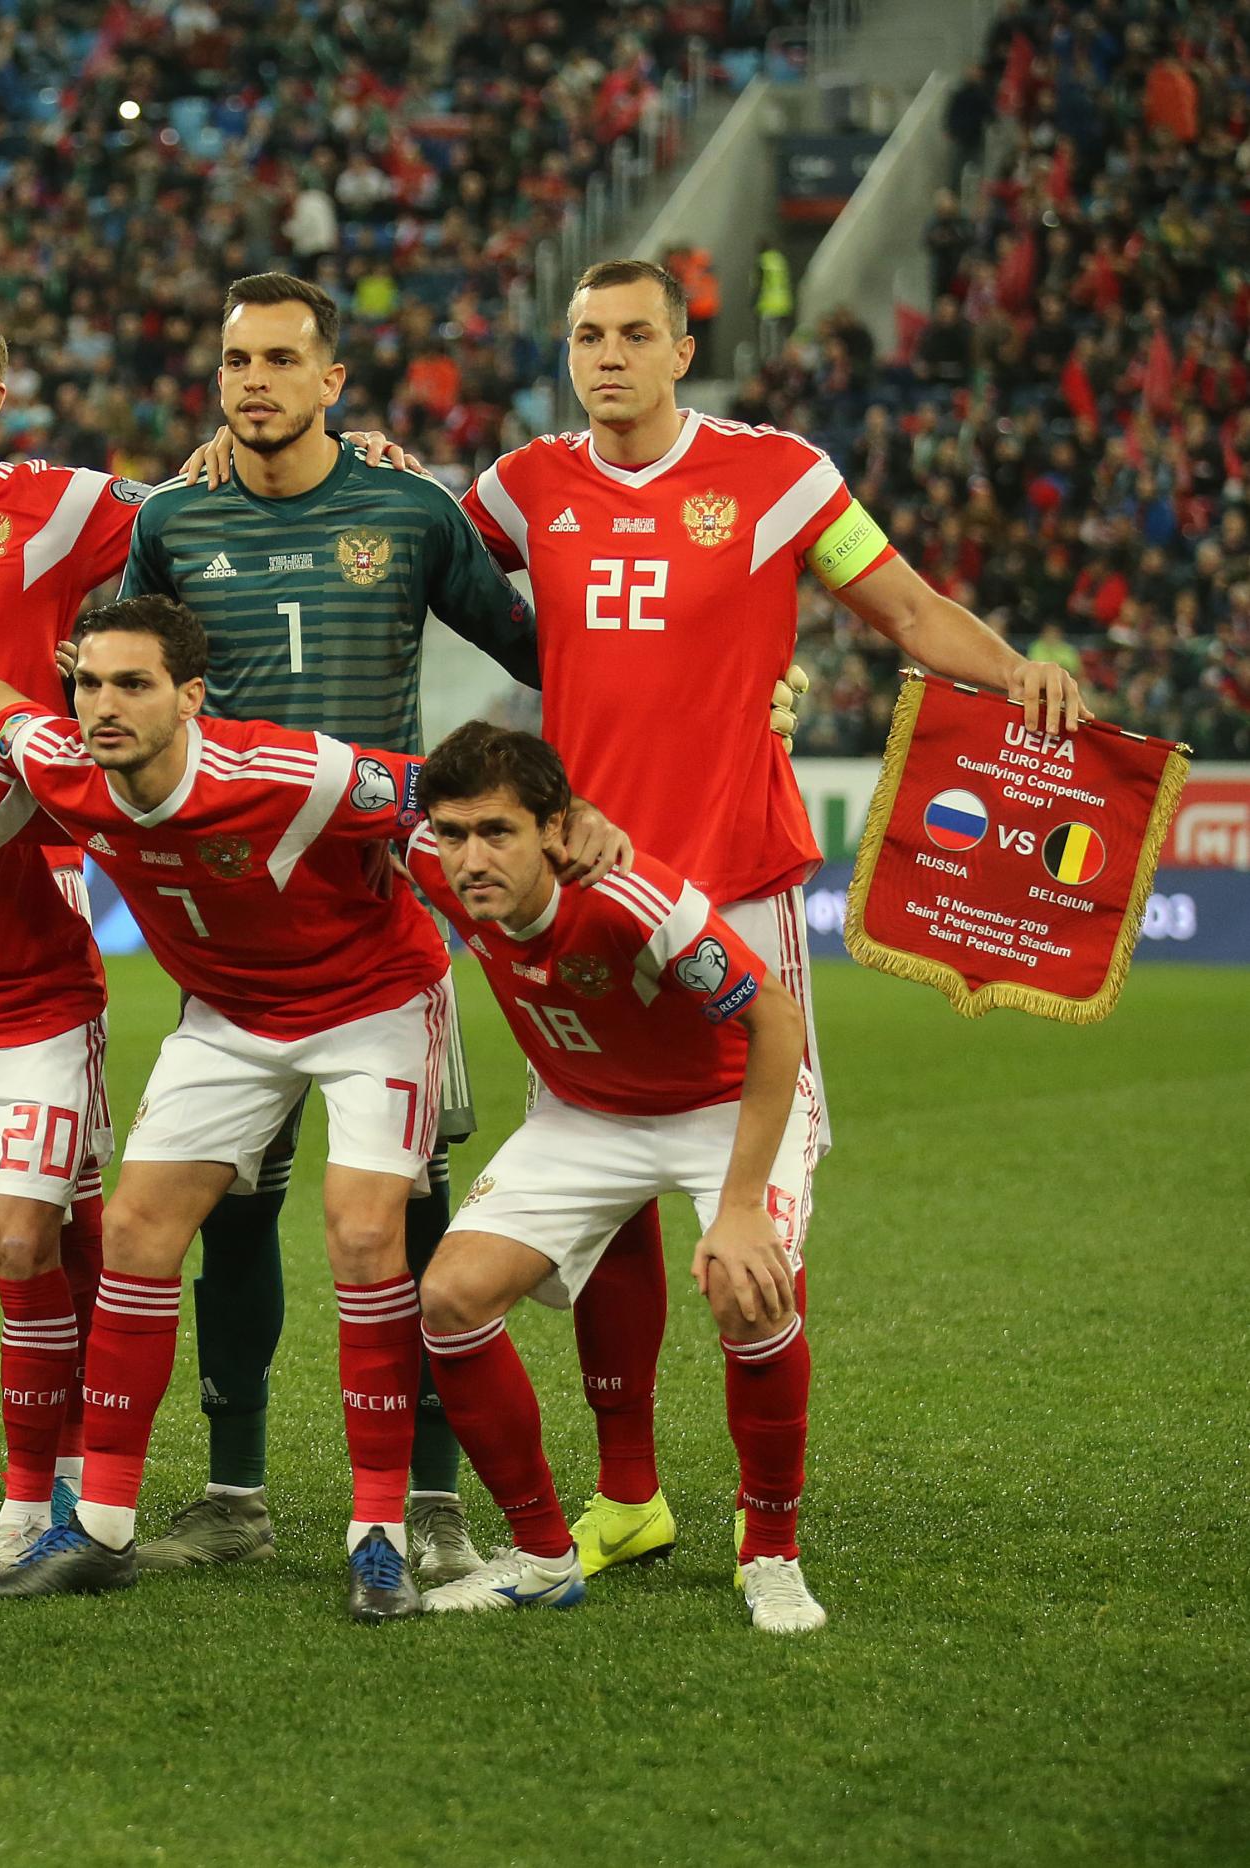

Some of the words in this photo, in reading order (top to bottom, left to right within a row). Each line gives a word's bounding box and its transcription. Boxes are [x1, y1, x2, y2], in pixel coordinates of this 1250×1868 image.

[548, 524, 581, 533] adidas
[203, 568, 238, 579] adidas
[585, 559, 669, 631] 22
[277, 602, 309, 673] 1
[1004, 721, 1076, 763] UEFA
[956, 755, 1025, 787] Qualifying
[1027, 771, 1106, 807] Competition
[998, 749, 1039, 771] EURO
[1042, 760, 1073, 780] 2020
[1002, 785, 1045, 809] Group
[996, 825, 1037, 856] VS
[915, 853, 968, 879] RUSSIA
[157, 886, 210, 938] 7
[934, 895, 950, 910] 16
[951, 898, 1017, 929] November
[1019, 917, 1049, 935] 2019
[1028, 886, 1094, 913] BELGIUM
[905, 901, 939, 923] Saint
[943, 911, 1014, 945] Petersburg
[1017, 932, 1071, 958] Stadium
[928, 925, 962, 945] Saint
[966, 934, 1038, 967] Petersburg
[514, 996, 602, 1053] 18
[385, 1077, 418, 1151] 7
[0, 1104, 79, 1180] 20
[3, 1387, 66, 1406] РОССИЯ
[343, 1389, 407, 1412] РОССИЯ
